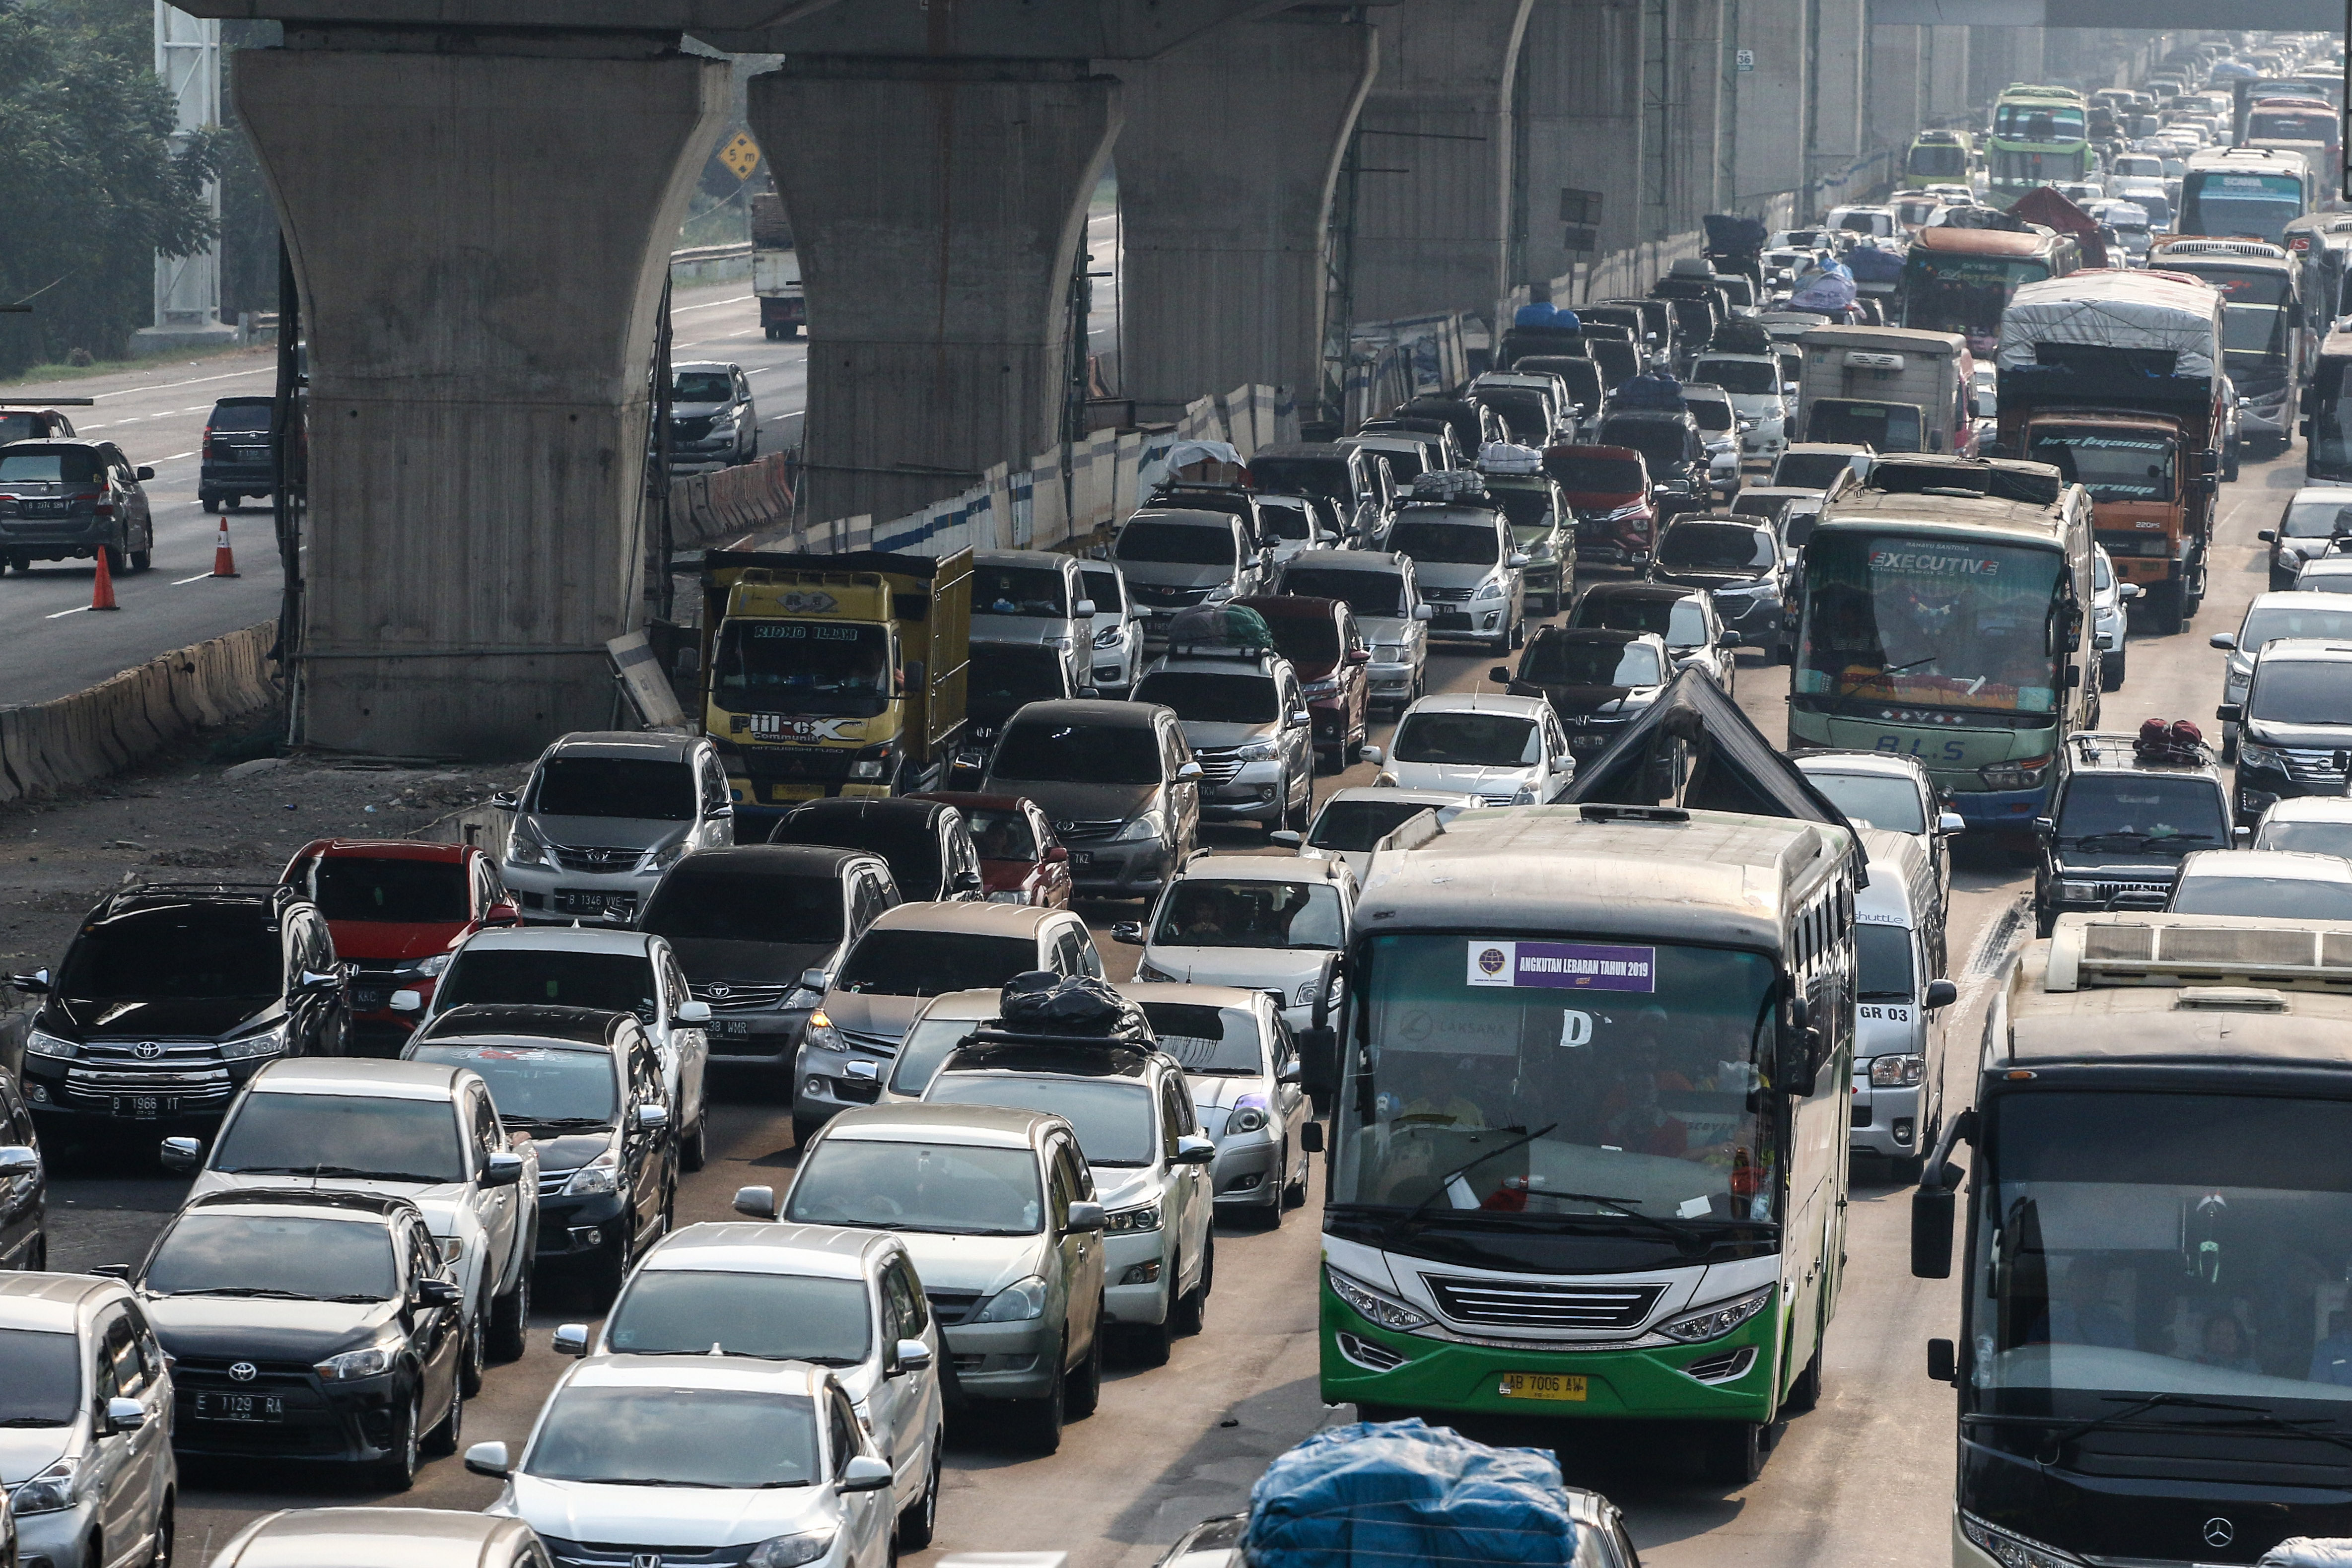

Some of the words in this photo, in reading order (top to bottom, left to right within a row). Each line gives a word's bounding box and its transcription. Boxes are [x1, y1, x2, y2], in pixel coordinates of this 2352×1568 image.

[1738, 55, 1751, 64] 36
[730, 149, 737, 161] 5
[745, 153, 755, 162] m
[1868, 552, 1999, 575] EXECUTIVE
[754, 625, 806, 638] RIDHO
[753, 732, 823, 743] Community
[1075, 854, 1089, 864] TKZ
[569, 895, 575, 904] B
[582, 895, 601, 905] 1346
[1519, 956, 1561, 973] ANGKUTAN
[1563, 959, 1598, 975] LEBARAN
[1600, 960, 1627, 976] TAHUN
[1628, 962, 1649, 977] 2019
[1860, 1007, 1882, 1019] GR
[1888, 1008, 1908, 1022] 03
[728, 1022, 747, 1033] WMR
[1560, 1009, 1592, 1047] D
[113, 1097, 120, 1109] B
[133, 1097, 157, 1109] 1966
[167, 1097, 179, 1109] YT
[1510, 1375, 1523, 1389] AB
[1530, 1376, 1559, 1391] 7006
[198, 1395, 206, 1410] E
[223, 1397, 252, 1411] 1129
[266, 1398, 282, 1413] RA
